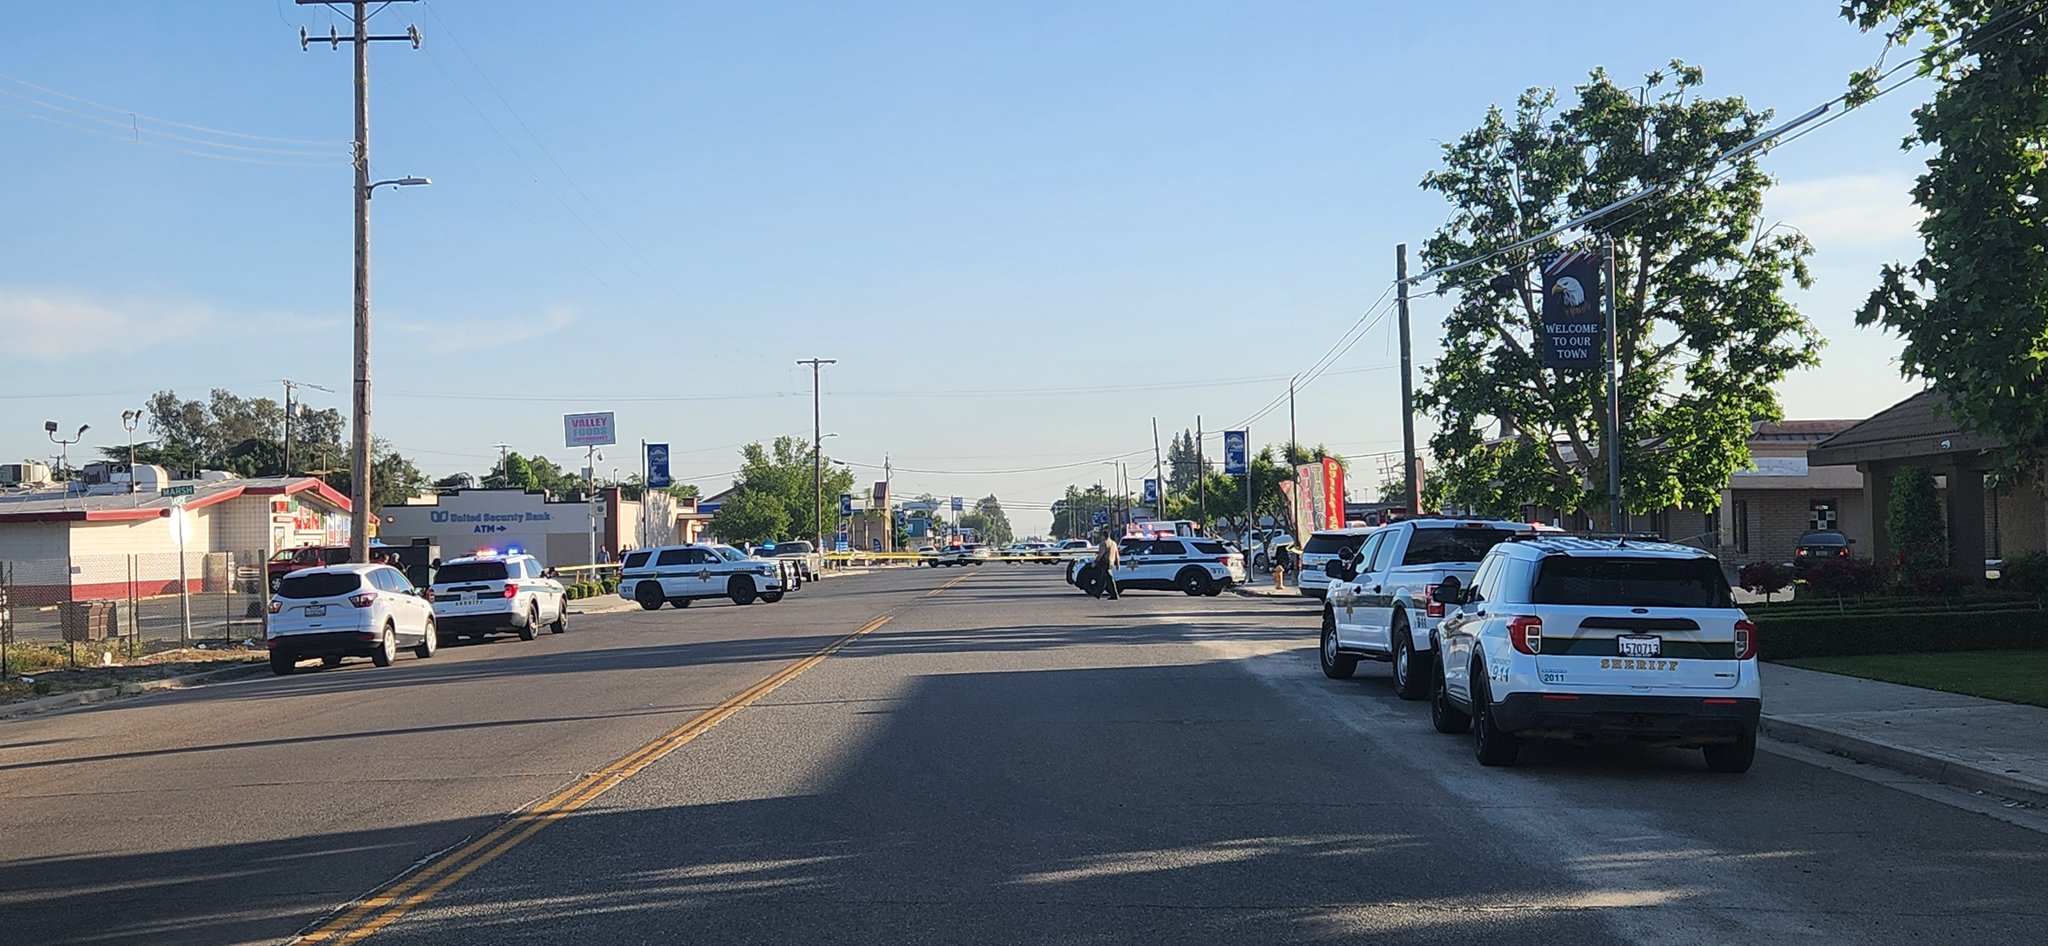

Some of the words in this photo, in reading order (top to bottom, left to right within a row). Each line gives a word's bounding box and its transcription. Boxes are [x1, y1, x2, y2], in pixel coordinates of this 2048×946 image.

[1545, 323, 1598, 334] WELCOME
[1552, 337, 1567, 346] TO
[1569, 337, 1591, 346] OUR
[1557, 349, 1588, 358] TOWN
[571, 417, 607, 428] VALLEY
[573, 427, 607, 436] FOODS
[163, 486, 193, 496] MARSH
[450, 513, 482, 522] United
[483, 513, 524, 523] Security
[525, 512, 551, 521] Bank
[474, 525, 495, 533] ATM
[1620, 643, 1659, 655] 1570713
[1601, 659, 1678, 671] SHERIFF
[1544, 673, 1564, 682] 2011
